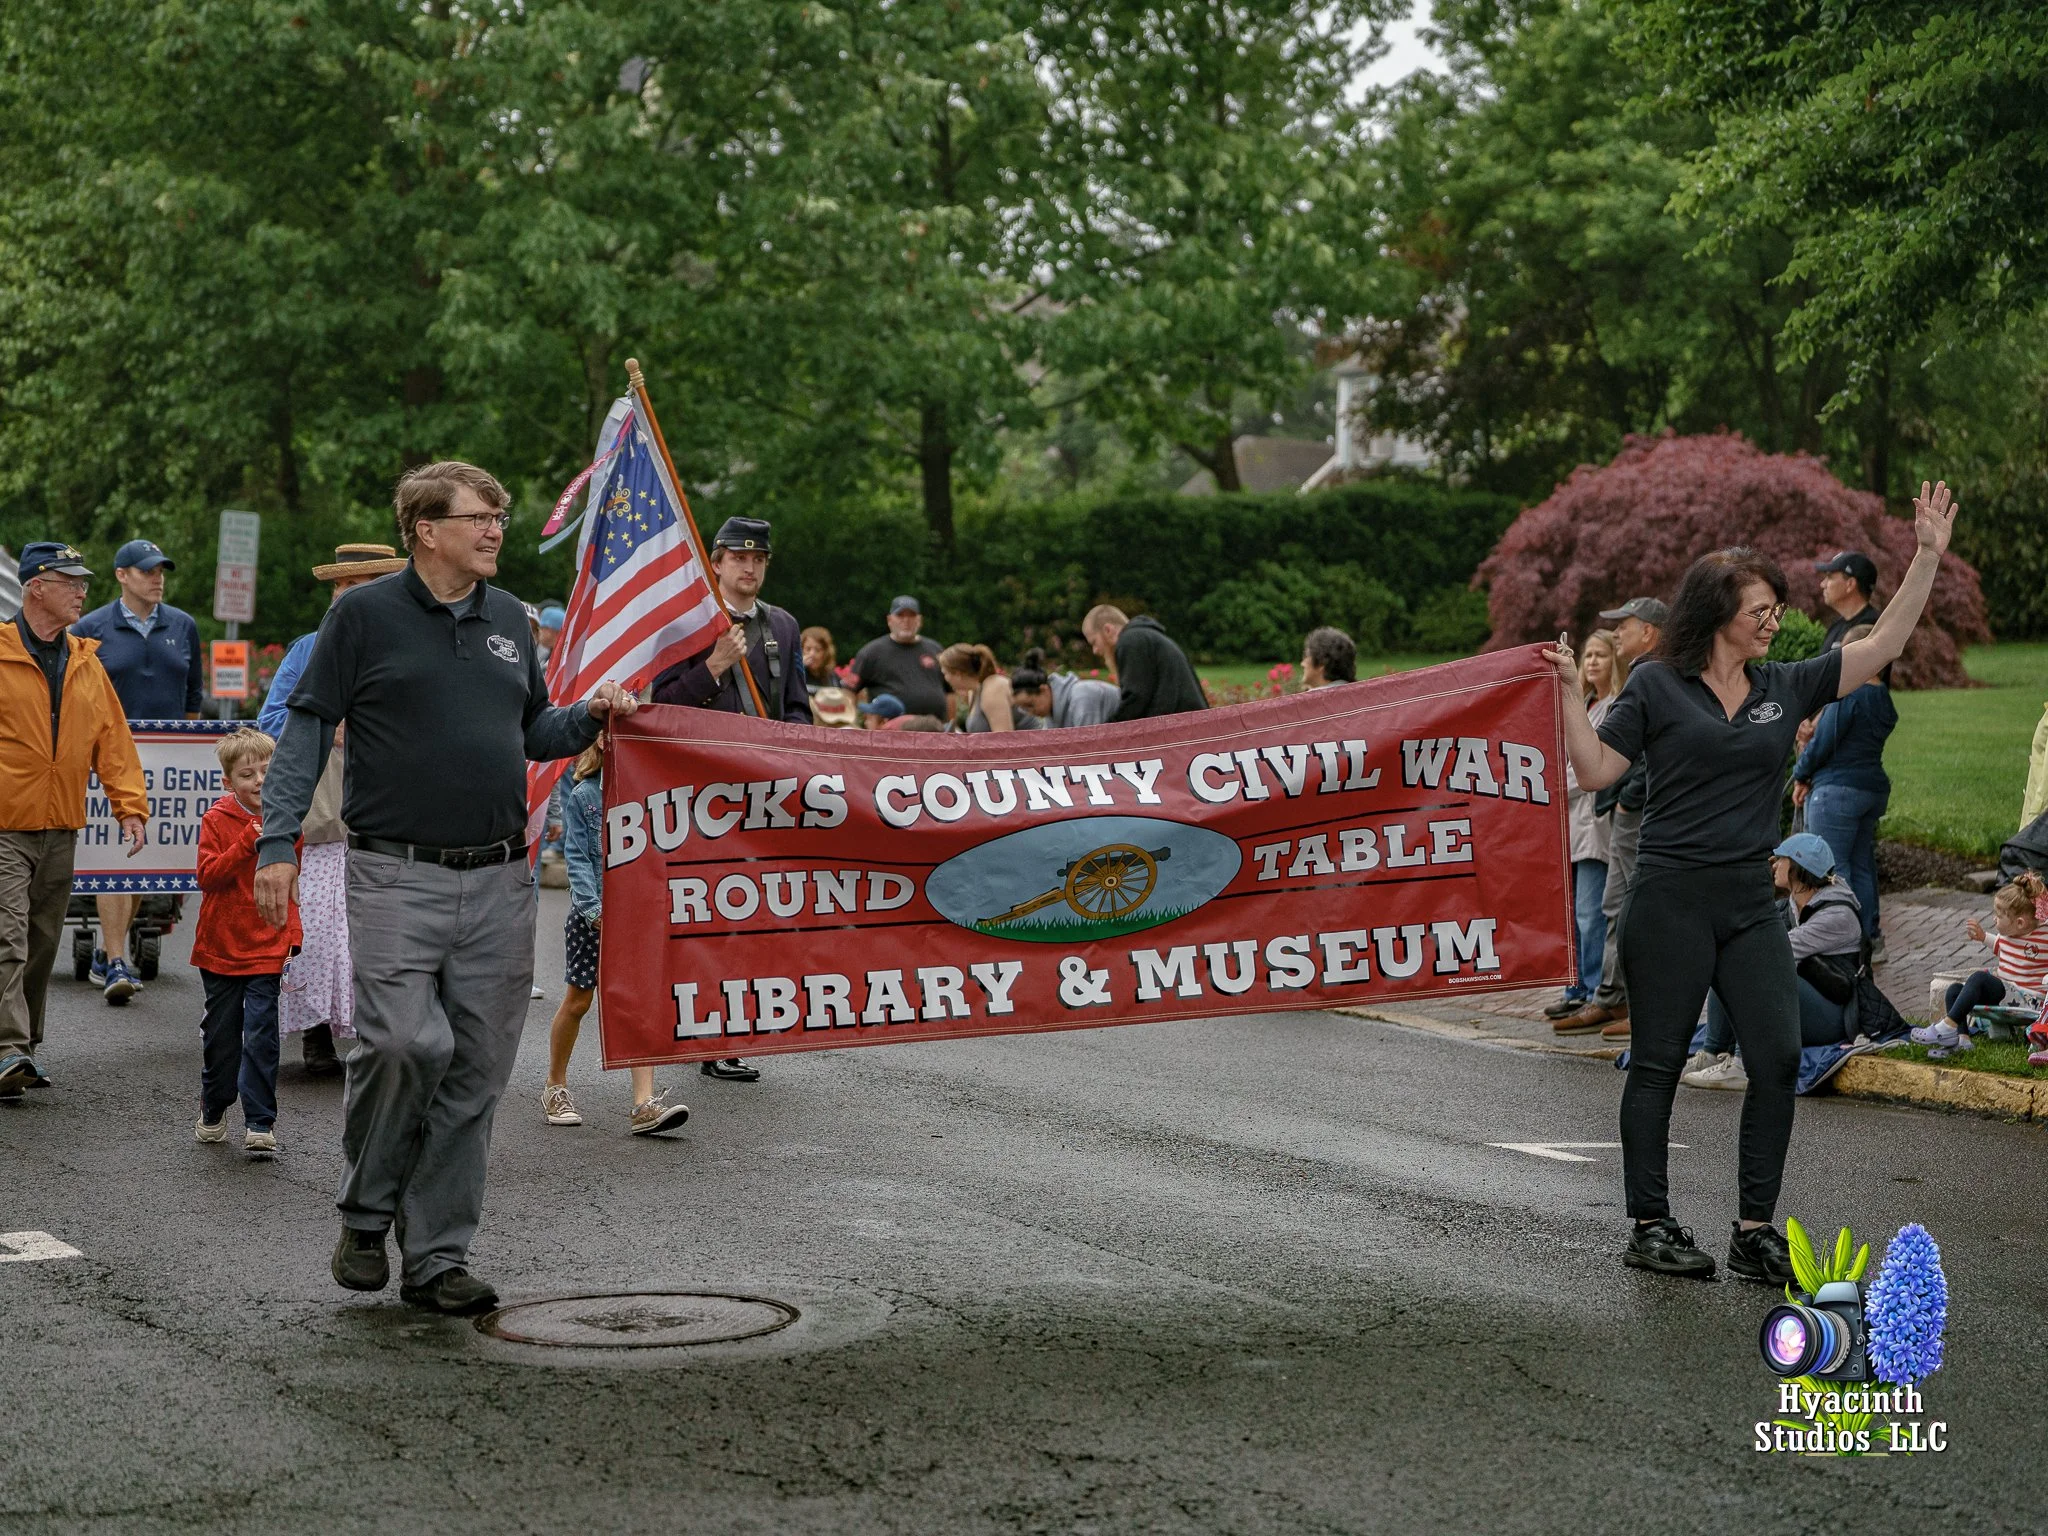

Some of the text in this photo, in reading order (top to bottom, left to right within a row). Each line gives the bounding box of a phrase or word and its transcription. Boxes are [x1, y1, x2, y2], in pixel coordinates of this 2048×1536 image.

[164, 767, 226, 791] GENE
[196, 797, 220, 818] O
[605, 736, 1550, 869] BUCKS COUNTY CIVIL WAR
[76, 824, 109, 845] TH
[668, 818, 1474, 925] ROUND TABLE
[673, 917, 1502, 1040] LIBRARY & MUSEUM
